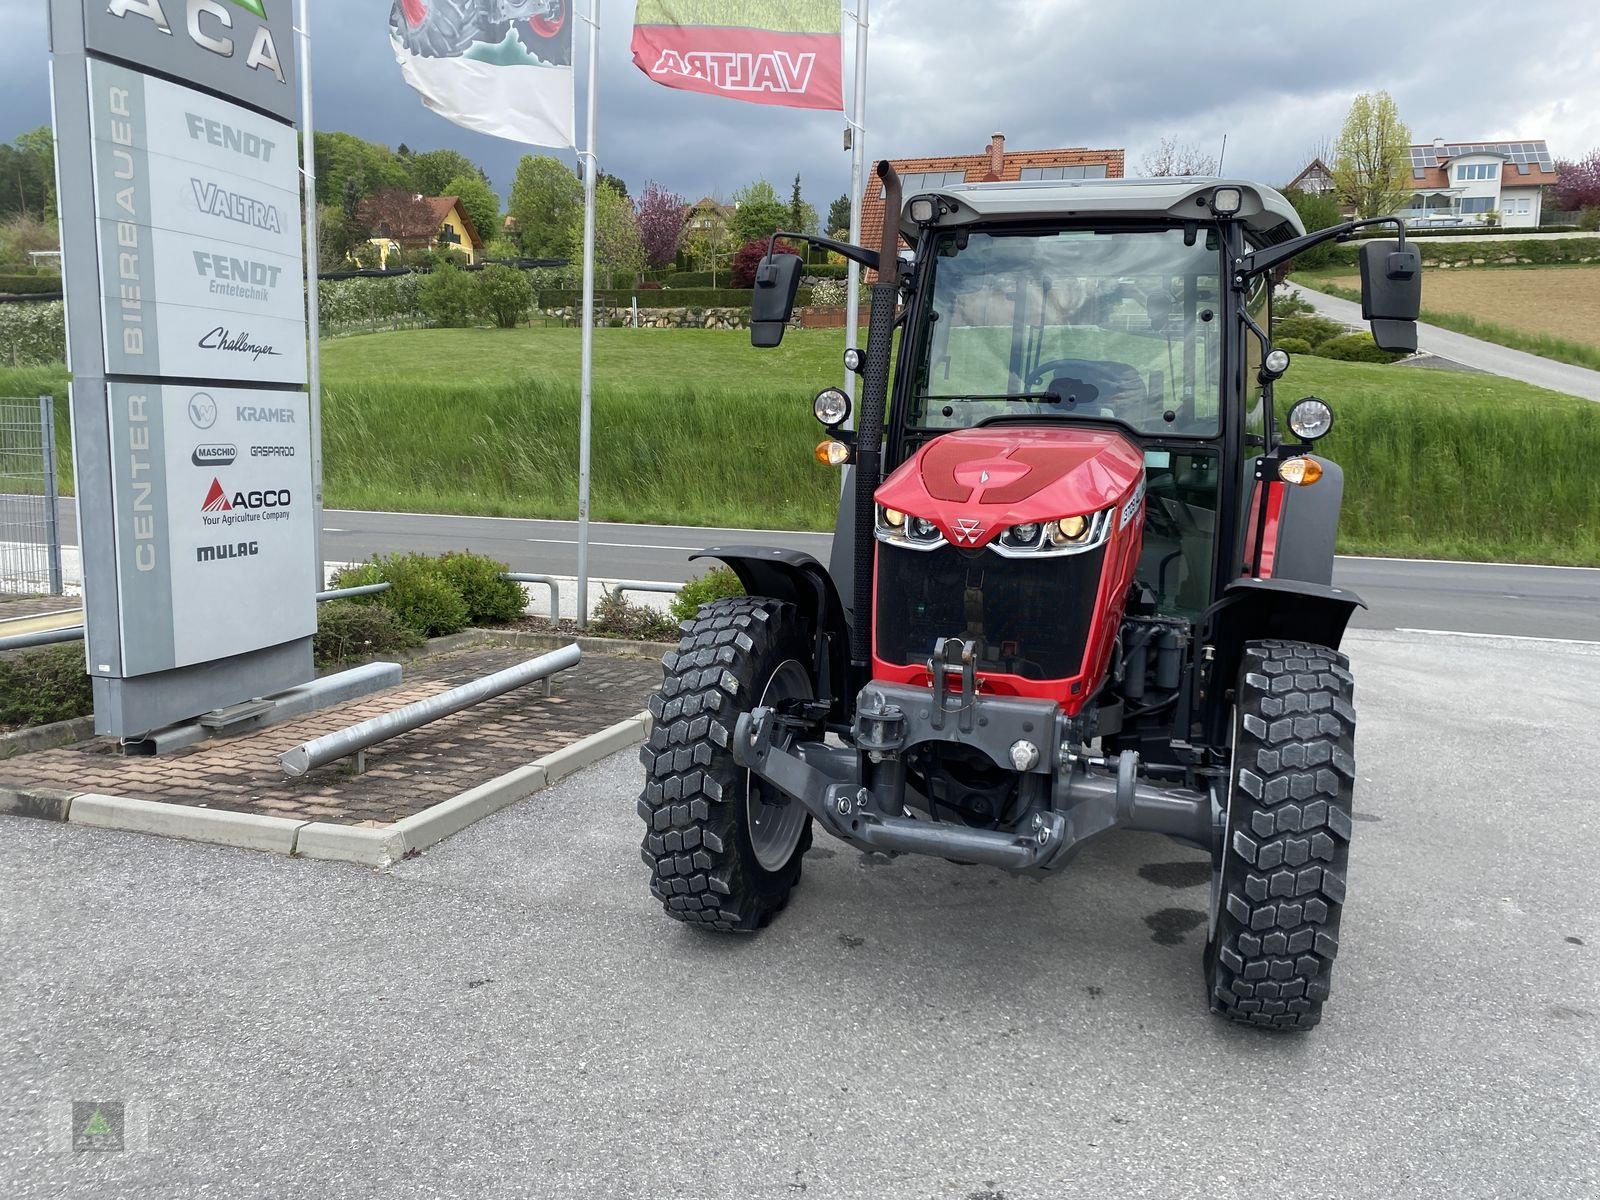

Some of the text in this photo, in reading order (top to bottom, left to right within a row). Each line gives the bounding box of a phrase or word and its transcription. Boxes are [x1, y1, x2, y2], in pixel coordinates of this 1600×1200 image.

[184, 112, 276, 163] FENDT
[109, 86, 144, 355] BIERBAUER
[190, 178, 281, 234] VALTRA
[192, 250, 282, 288] FENDT
[209, 279, 269, 301] Erntetechnik
[198, 326, 284, 362] Challenger
[236, 406, 296, 423] KRAMER
[198, 446, 295, 457] MASCHIO GASPARDO
[128, 395, 156, 572] CENTER
[232, 489, 291, 509] AGCO
[203, 511, 290, 526] Your Agriculture Company
[196, 541, 259, 562] MULAG
